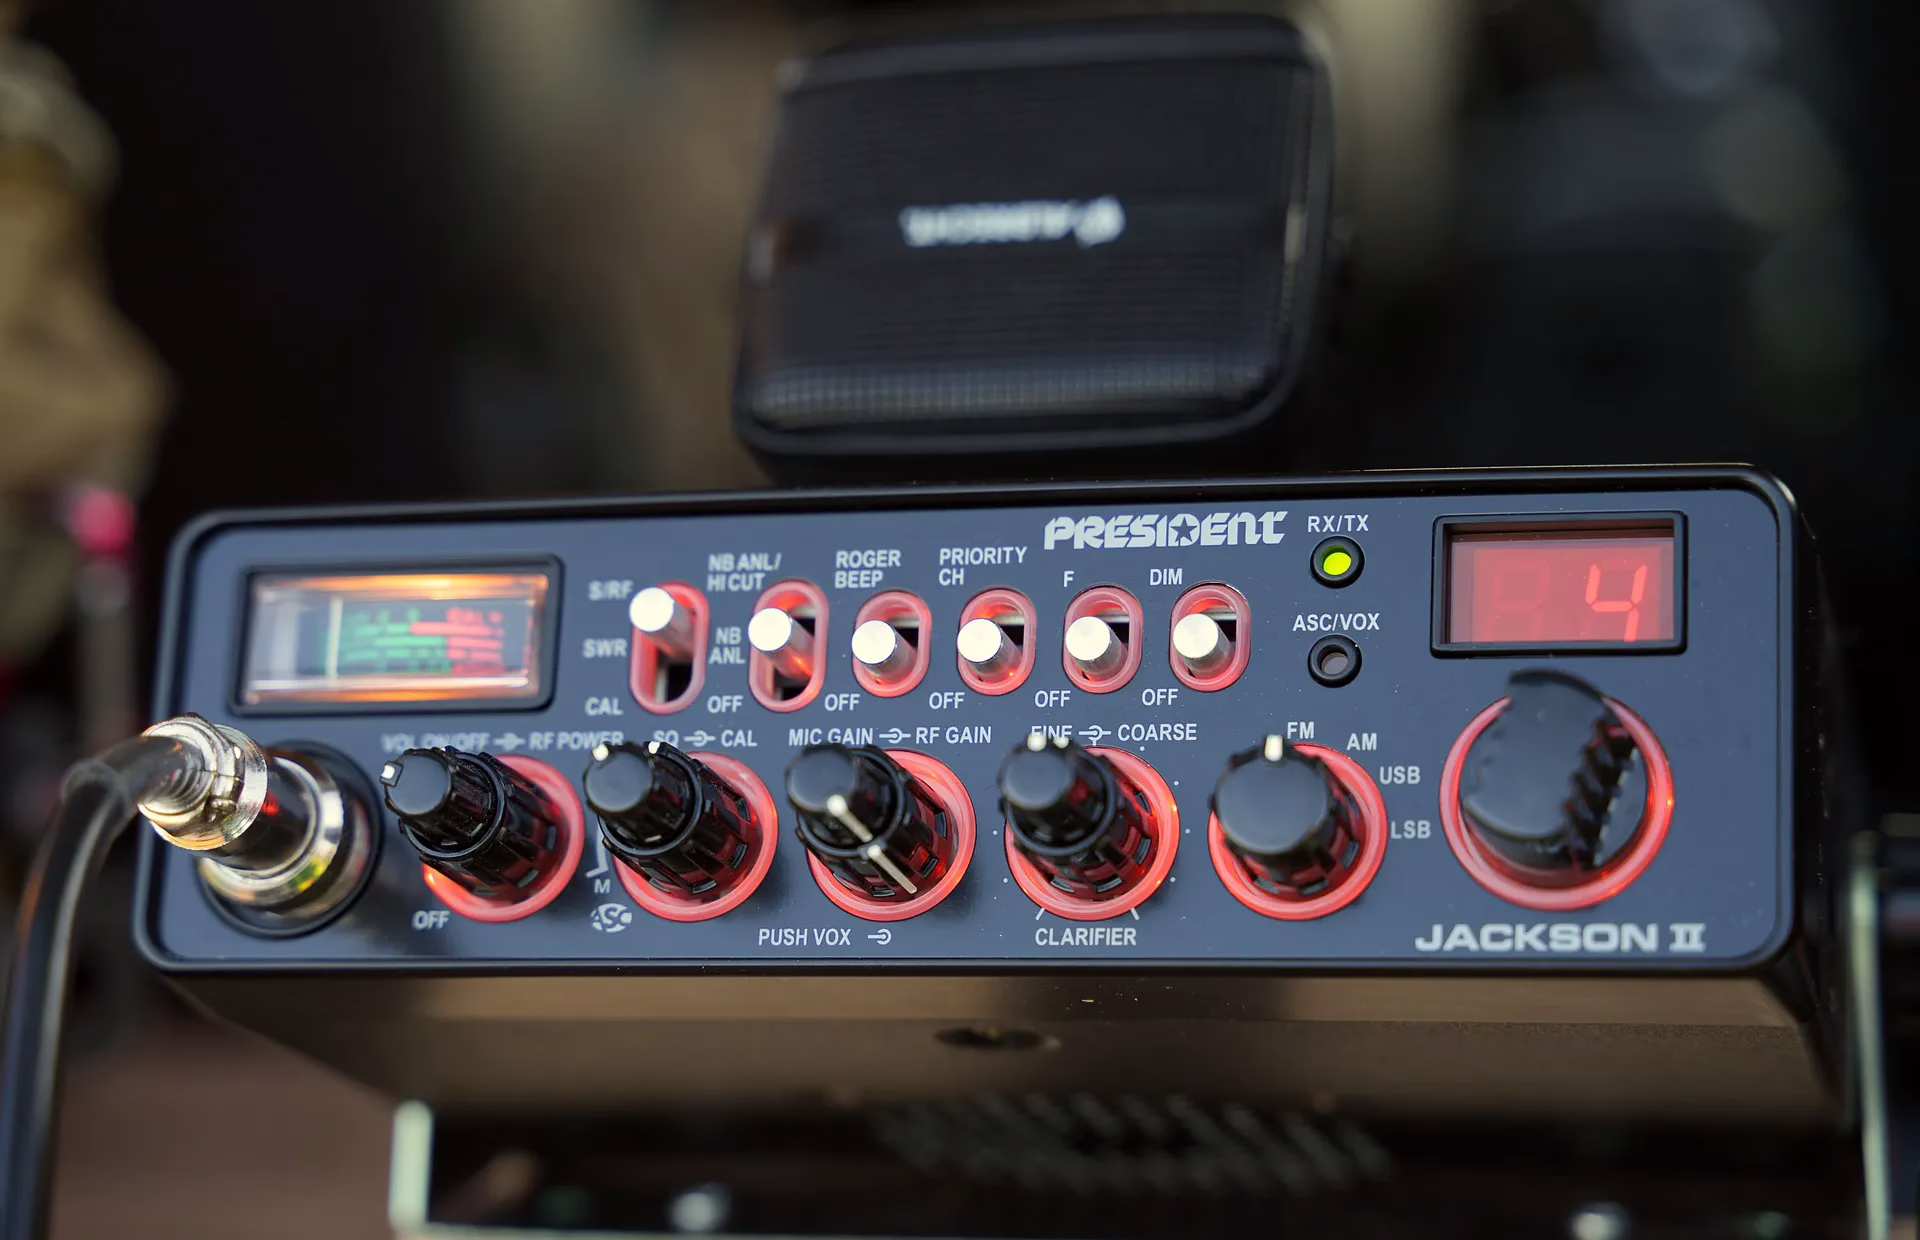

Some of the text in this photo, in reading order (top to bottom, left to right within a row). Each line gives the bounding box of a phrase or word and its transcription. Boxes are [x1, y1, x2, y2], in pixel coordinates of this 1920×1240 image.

[1044, 511, 1288, 550] PRESIDENT
[1307, 514, 1369, 532] RX/TX
[708, 553, 782, 572] NB ANL/
[836, 549, 901, 568] ROGER
[939, 546, 1027, 565] PRIORITY
[708, 573, 765, 591] HI CUT
[834, 571, 883, 588] BEEP
[939, 568, 964, 586] CH
[1063, 571, 1075, 587] F
[1149, 568, 1183, 585] DIM
[589, 580, 633, 600] S/RF
[1585, 564, 1647, 642] 4
[1293, 613, 1380, 631] ASC/VOX
[716, 627, 741, 645] NB
[583, 638, 627, 658] SWR
[709, 647, 745, 664] ANL
[707, 696, 743, 713] OFF
[824, 694, 860, 711] OFF
[929, 692, 965, 709] OFF
[1034, 690, 1071, 708] OFF
[1142, 689, 1178, 706] OFF
[585, 698, 623, 716] CAL
[721, 729, 758, 747] CAL
[789, 726, 991, 746] MIC GAIN RF GAIN
[1117, 723, 1197, 742] COARSE
[1287, 722, 1315, 739] FM
[528, 732, 554, 749] RF
[557, 731, 624, 749] POWER
[1346, 733, 1377, 751] AM
[1379, 766, 1421, 785] USB
[1391, 820, 1431, 840] LSB
[413, 910, 450, 930] OFF
[758, 929, 851, 946] PUSH VOX
[1035, 928, 1137, 946] CLARIFIER
[1415, 923, 1706, 952] JACKSON II
